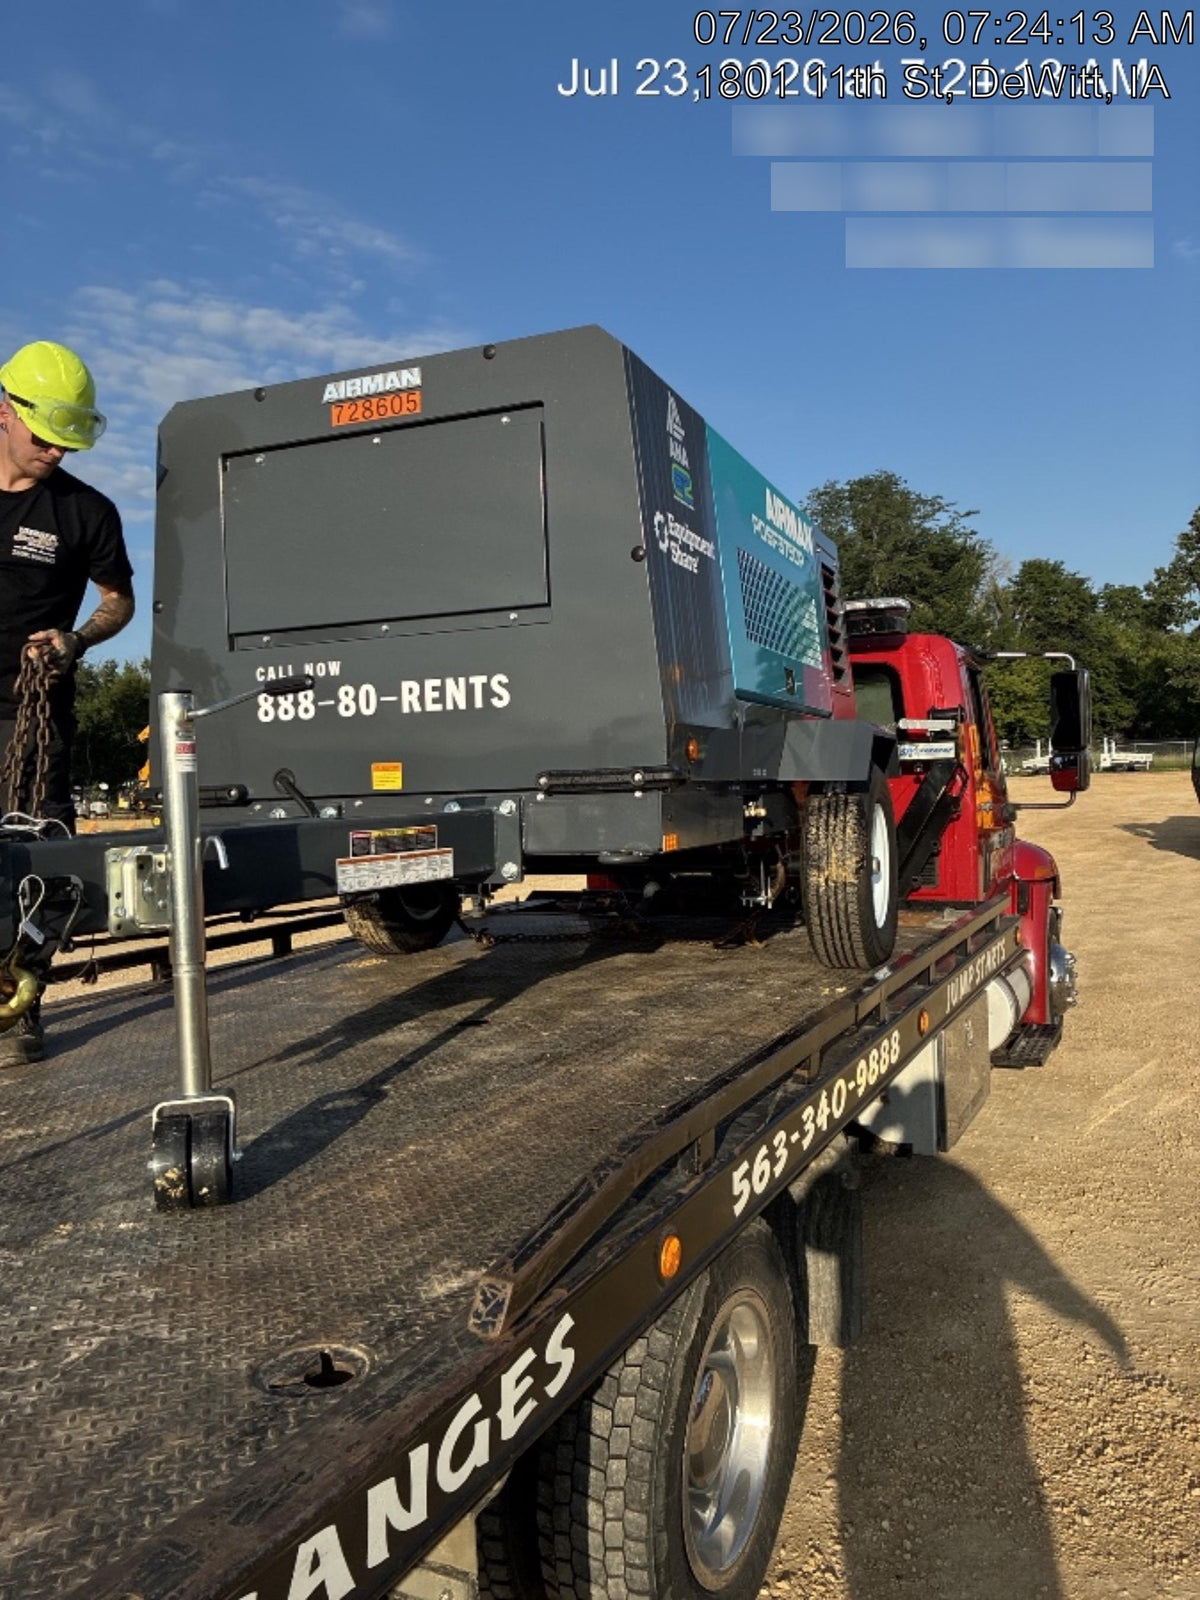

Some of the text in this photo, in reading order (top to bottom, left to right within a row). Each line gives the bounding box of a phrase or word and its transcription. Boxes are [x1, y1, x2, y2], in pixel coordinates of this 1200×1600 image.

[322, 367, 422, 405] AIRMAN
[333, 392, 418, 424] 728605
[304, 660, 341, 677] NOW
[257, 673, 511, 723] 888-80-RENTS
[732, 1029, 901, 1217] 563-340-9888
[237, 1312, 576, 1600] ANGES
